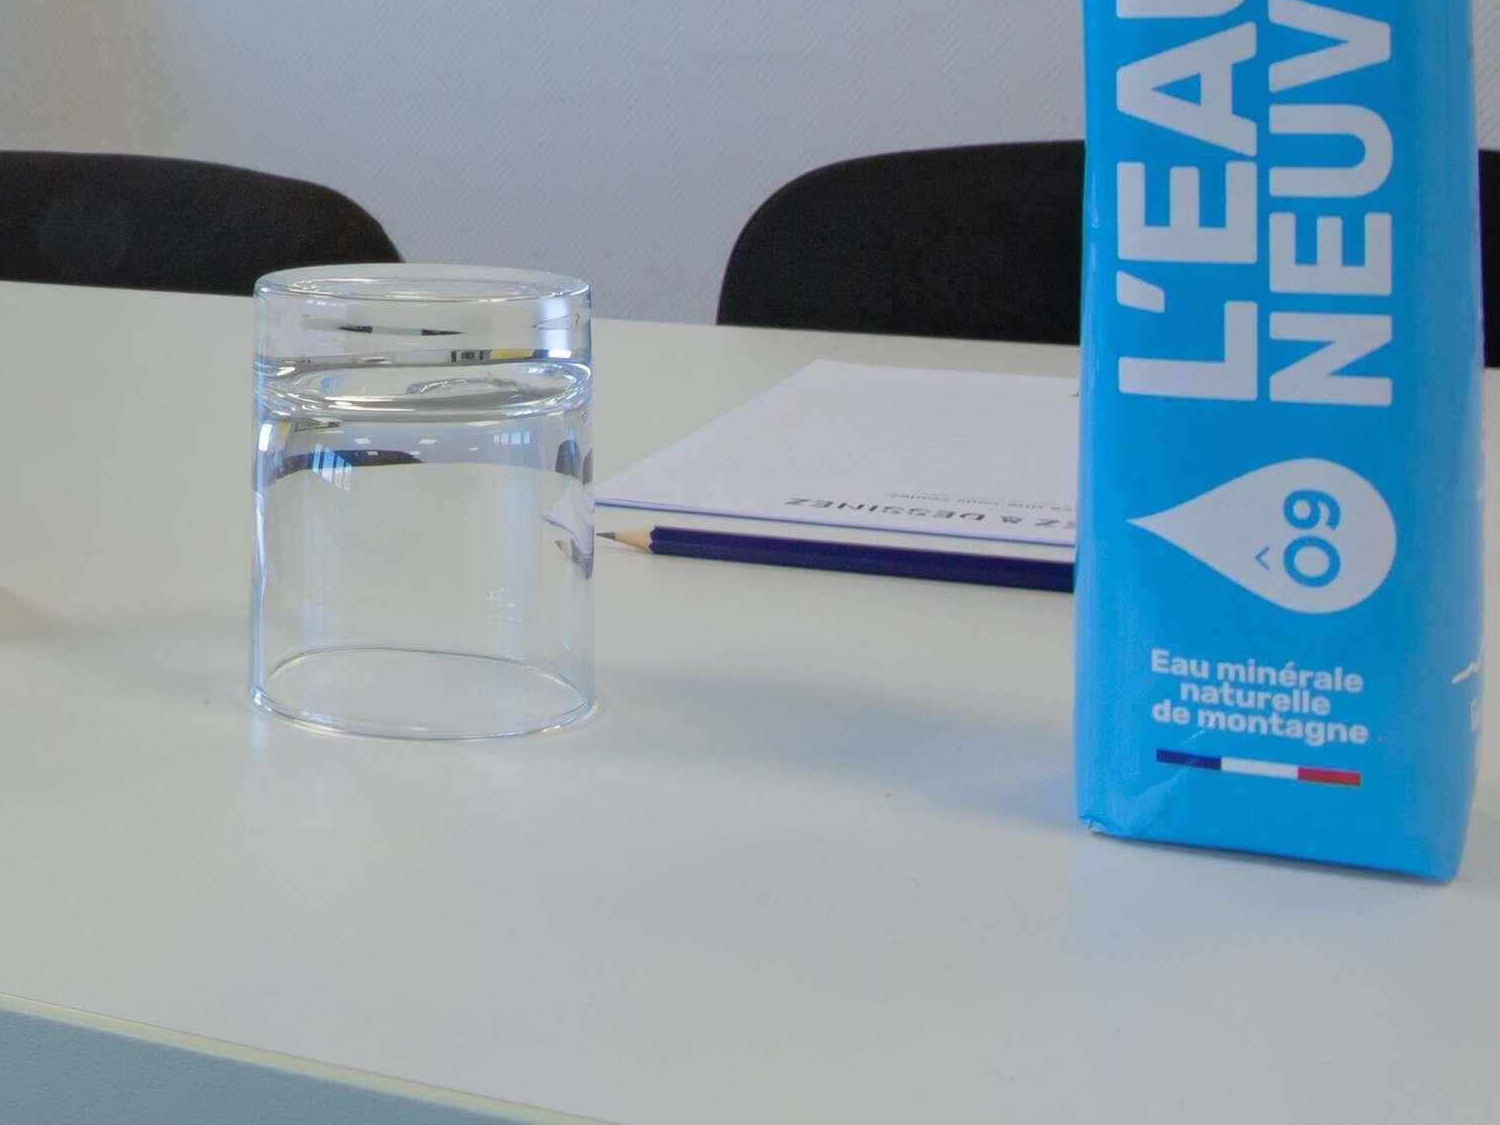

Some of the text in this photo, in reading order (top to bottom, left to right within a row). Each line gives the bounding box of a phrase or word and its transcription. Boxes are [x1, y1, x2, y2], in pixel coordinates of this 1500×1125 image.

[783, 495, 987, 524] DESSINEZ
[1151, 647, 1364, 694] Eau minérale
[1180, 681, 1331, 716] naturelle
[1151, 698, 1370, 747] de montagne
